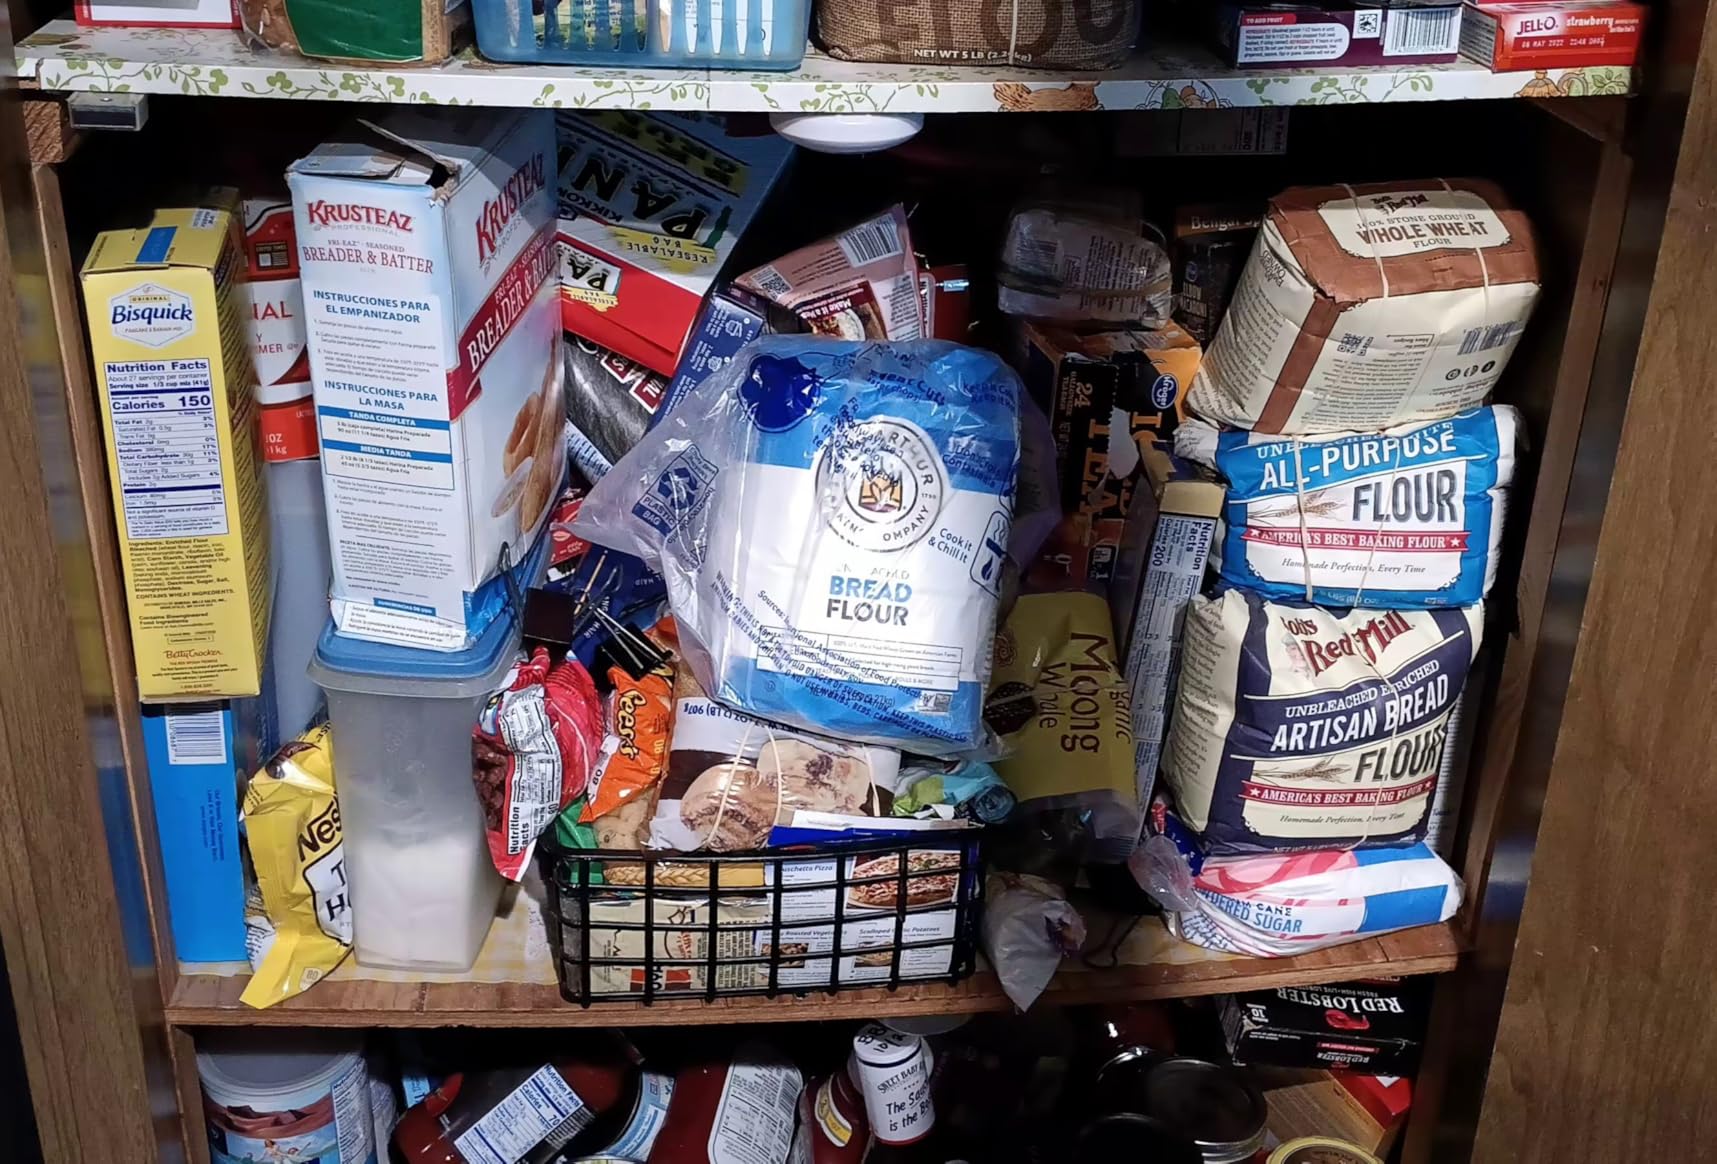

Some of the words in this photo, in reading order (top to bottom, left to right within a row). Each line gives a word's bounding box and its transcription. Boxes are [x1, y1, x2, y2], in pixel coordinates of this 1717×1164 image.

[1567, 16, 1614, 28] strawberry
[914, 50, 936, 59] NET
[939, 50, 960, 59] WT
[961, 51, 968, 59] 5
[971, 52, 985, 60] LB
[308, 200, 412, 232] KRUSTEAZ
[476, 152, 546, 263] KRUSTEAZ
[1386, 216, 1426, 225] STONE
[652, 236, 682, 248] BAG
[1356, 224, 1426, 244] WHOLE
[1426, 222, 1489, 236] WHEAT
[1413, 238, 1452, 248] FLOUR
[366, 242, 404, 252] SEASONED
[626, 242, 708, 264] RESEALABLE
[302, 246, 363, 264] BREADER
[367, 251, 377, 264] &
[381, 251, 433, 274] BATTER
[313, 290, 398, 308] INSTRUCCIONES
[400, 300, 430, 311] PARA
[112, 303, 193, 325] Bisquick
[326, 305, 338, 314] EL
[341, 307, 420, 323] EMPANIZADOR
[466, 294, 524, 373] BREADER
[524, 269, 533, 300] &
[107, 363, 165, 372] Nutrition
[171, 361, 207, 370] Facts
[325, 380, 406, 399] INSTRUCCIONES
[409, 392, 438, 402] PARA
[1075, 382, 1092, 409] 24
[1158, 377, 1174, 407] Kroger
[113, 401, 165, 410] Calories
[179, 395, 210, 407] 150
[359, 398, 371, 406] LA
[374, 400, 404, 410] MASA
[349, 412, 375, 421] TANDA
[376, 416, 416, 426] COMPLETA
[361, 446, 384, 454] MEDIA
[386, 449, 412, 458] TANDA
[1260, 429, 1457, 490] ALL-PURPOSE
[1352, 469, 1458, 522] FLOUR
[642, 497, 677, 525] PLASTIC
[642, 510, 660, 525] BAG
[883, 505, 929, 541] OMPANY
[1158, 518, 1174, 548] Calories
[939, 527, 963, 547] Cook
[1186, 520, 1200, 553] Facts
[1191, 521, 1212, 570] Nutrition
[1324, 534, 1355, 545] BEST
[1408, 536, 1446, 548] FLOUR
[928, 536, 936, 547] &
[936, 539, 960, 562] Chill
[1152, 545, 1166, 567] 200
[1378, 564, 1401, 573] Every
[1405, 565, 1426, 573] Time
[829, 575, 913, 603] BREAD
[757, 590, 785, 620] Sources:
[826, 598, 909, 627] FLOUR
[1301, 632, 1357, 677] Red
[1352, 609, 1412, 665] Mill
[870, 669, 890, 684] Food
[1060, 632, 1111, 753] Moong
[1286, 687, 1378, 718] UNBLEACHED
[684, 702, 704, 715] 907g
[707, 703, 720, 717] LB)
[1270, 708, 1378, 751] ARTISAN
[1383, 674, 1449, 731] BREAD
[1353, 723, 1446, 783] FLOUR
[1261, 790, 1323, 803] AMERICA'S
[1323, 794, 1352, 803] BEST
[1396, 786, 1423, 800] FLOUR
[510, 806, 520, 854] Nutrition
[1280, 815, 1324, 823] Homemade
[1256, 903, 1292, 916] CANE
[1253, 912, 1302, 933] SUGAR
[1276, 987, 1355, 1013] LOBSTER
[1362, 997, 1404, 1013] RED
[1251, 1008, 1265, 1017] 10
[1316, 1051, 1351, 1062] LOBSTER
[1351, 1055, 1370, 1063] RED
[544, 1065, 567, 1093] Nutrition
[877, 1076, 901, 1094] SWEET
[900, 1064, 918, 1080] BABY
[522, 1084, 542, 1109] Calories
[548, 1114, 560, 1126] 70
[886, 1102, 906, 1115] The
[890, 1122, 898, 1132] is
[902, 1112, 917, 1128] the
